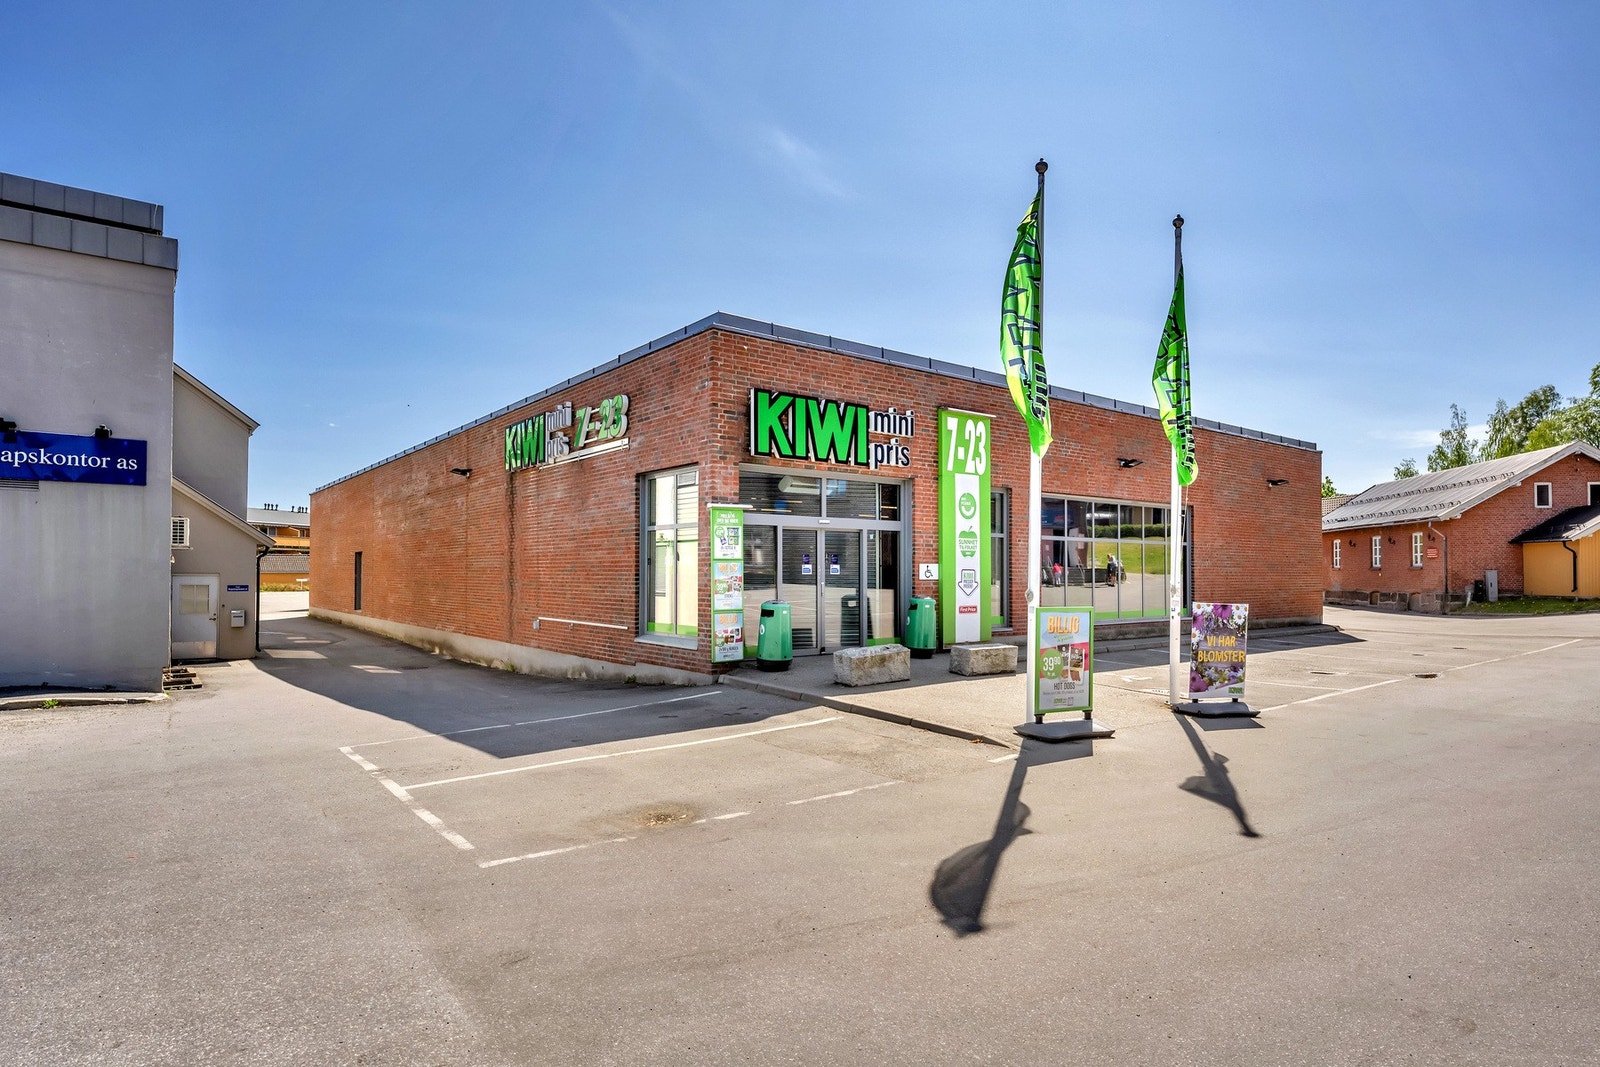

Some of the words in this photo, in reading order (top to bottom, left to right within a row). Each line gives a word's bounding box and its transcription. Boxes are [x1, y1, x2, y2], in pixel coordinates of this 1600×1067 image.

[573, 394, 630, 447] 7-23
[751, 388, 869, 467] KIWI
[870, 407, 914, 437] mini
[505, 412, 547, 471] KIWI
[870, 438, 911, 470] pris
[946, 416, 987, 476] 7-23
[0, 448, 111, 468] apskontor
[116, 457, 138, 470] as
[1047, 615, 1080, 634] BILLIG
[1197, 650, 1246, 662] BLOMSTER
[1207, 635, 1216, 647] VI
[1218, 635, 1236, 647] HAR
[1053, 682, 1063, 691] HOT
[1063, 681, 1076, 690] DOGS
